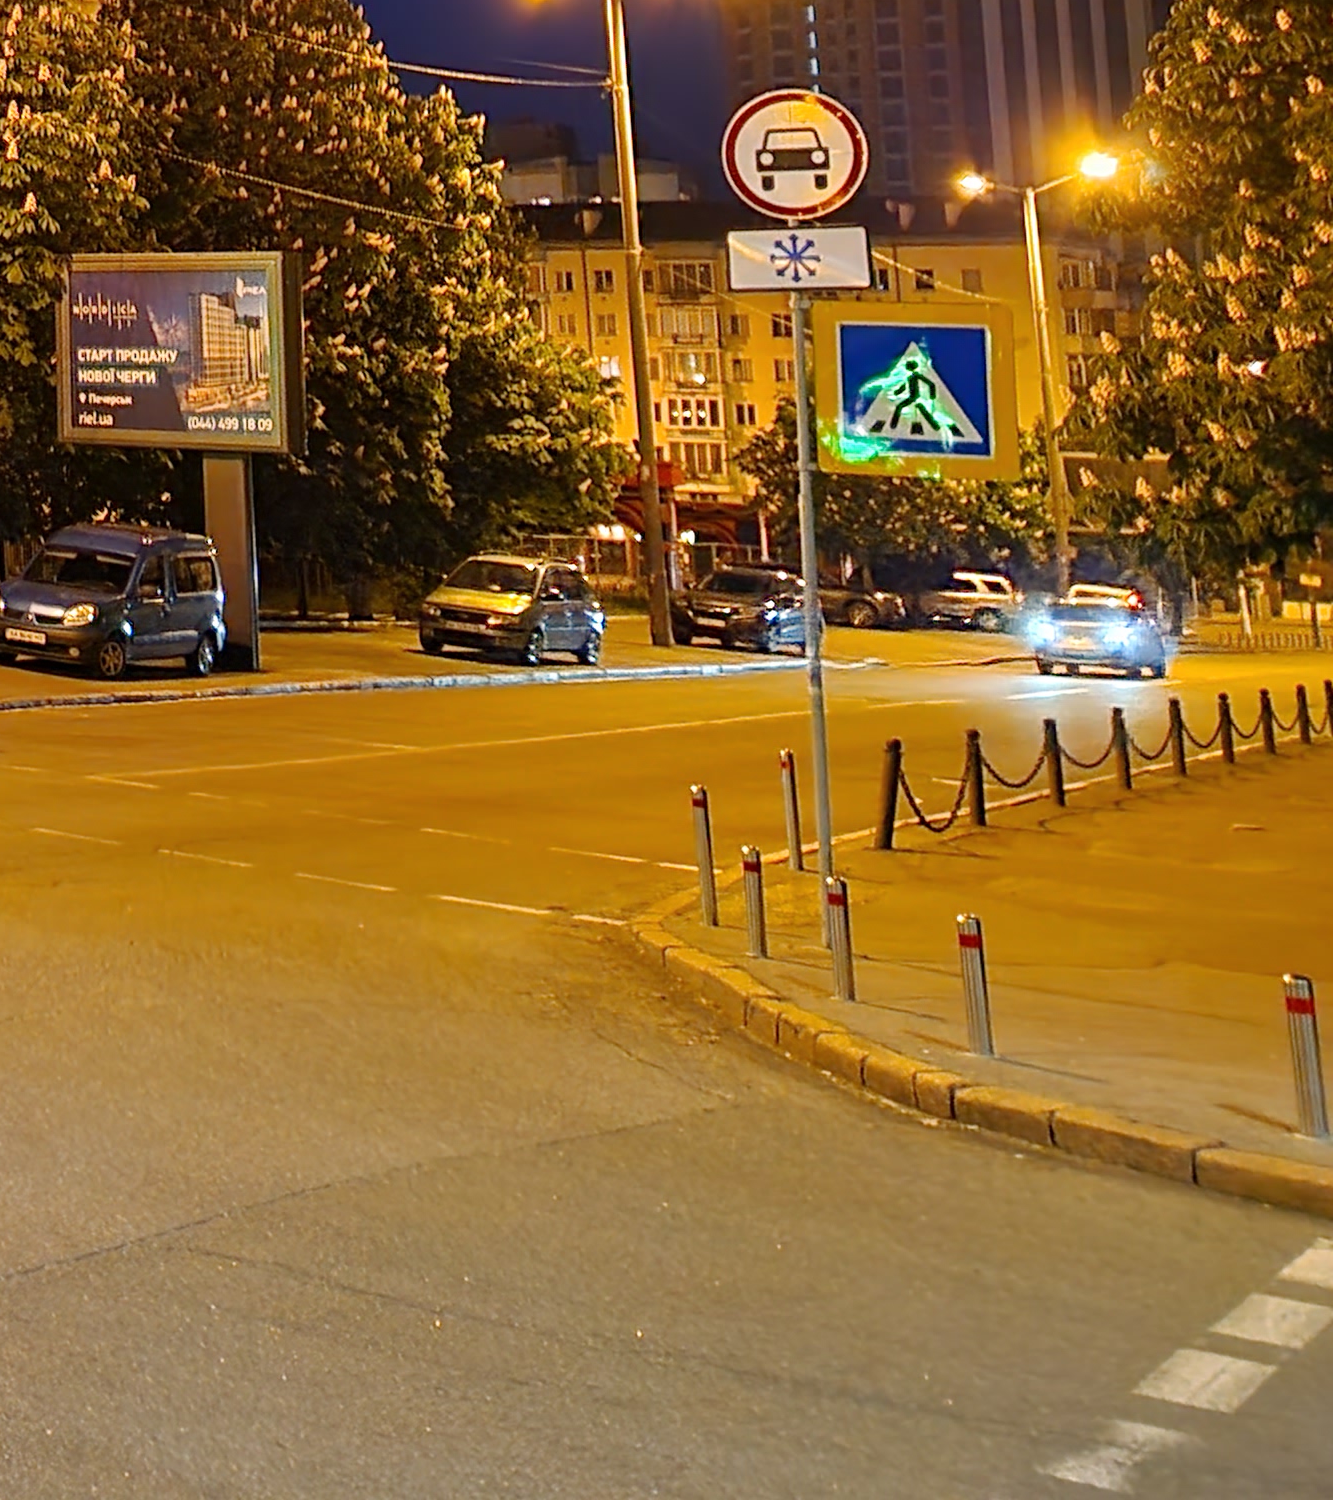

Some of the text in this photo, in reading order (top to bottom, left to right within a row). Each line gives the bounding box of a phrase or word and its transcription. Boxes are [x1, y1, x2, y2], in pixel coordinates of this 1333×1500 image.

[77, 348, 178, 365] СТАРТ ПРОДАЖУ
[78, 367, 157, 384] НОВОЇ ЧЕРГИ
[78, 411, 113, 426] riel.ua
[187, 416, 216, 431] (044)
[218, 417, 239, 431] 499
[257, 418, 273, 431] 09
